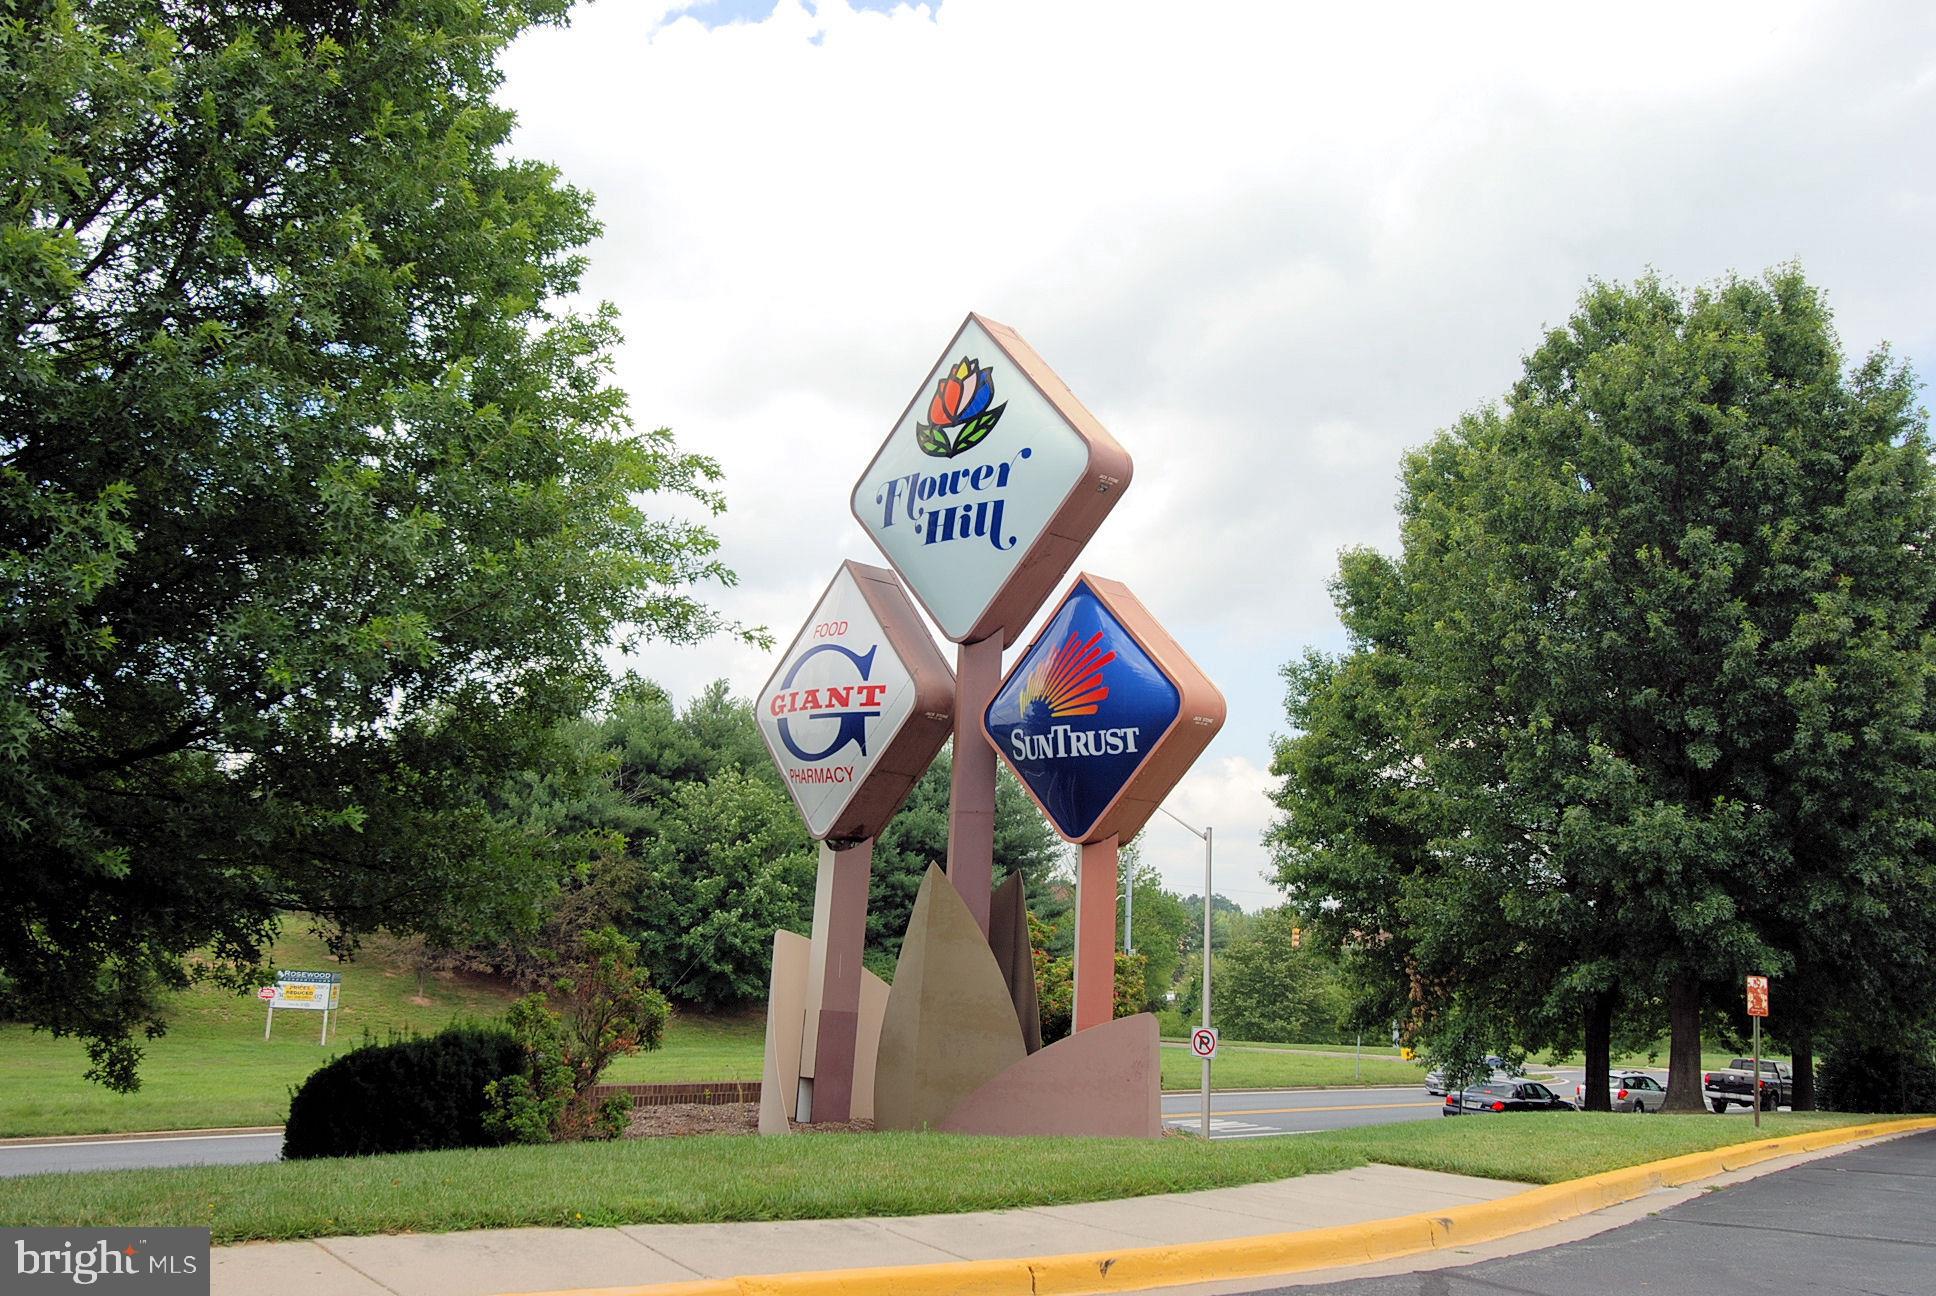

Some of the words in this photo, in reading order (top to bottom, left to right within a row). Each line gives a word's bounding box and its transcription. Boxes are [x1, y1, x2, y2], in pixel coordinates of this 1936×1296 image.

[876, 447, 1032, 529] Flower
[915, 499, 1017, 551] Hill
[813, 621, 848, 639] FOOD
[770, 685, 887, 717] GIANT
[789, 766, 854, 784] PHARMACY
[284, 970, 331, 979] ROSEWOOD
